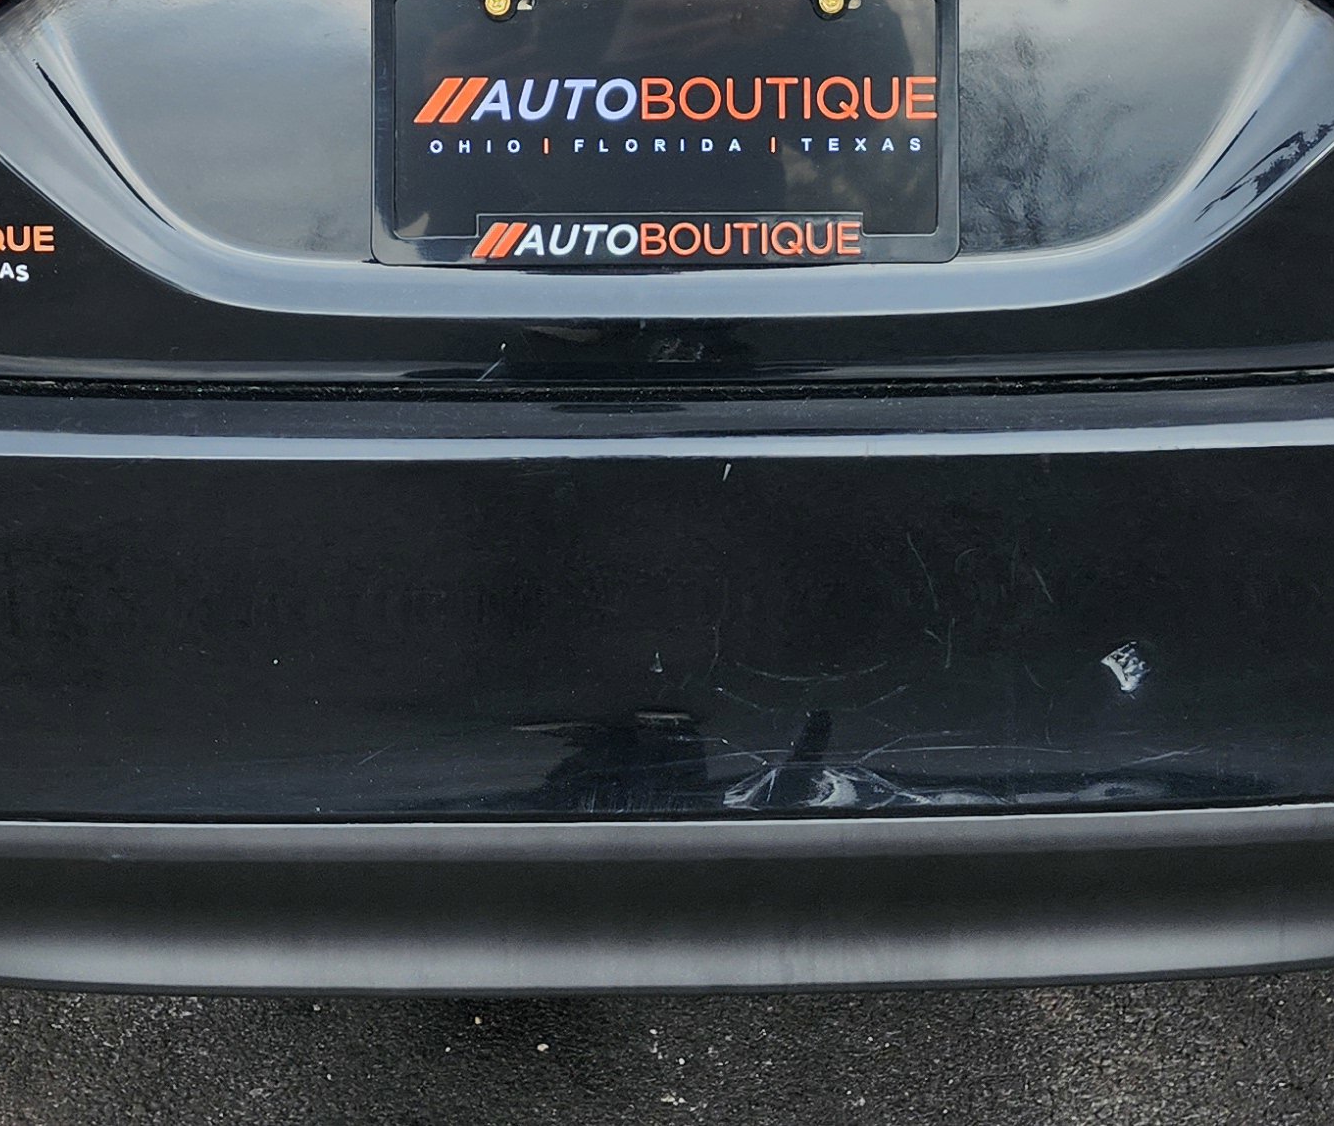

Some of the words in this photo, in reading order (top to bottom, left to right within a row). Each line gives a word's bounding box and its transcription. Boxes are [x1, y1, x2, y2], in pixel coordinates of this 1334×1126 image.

[471, 76, 938, 122] AUTOBOUTIQUE
[429, 139, 522, 155] OHIO
[573, 138, 743, 154] FLORIDA
[801, 137, 923, 153] TEXAS
[514, 221, 862, 258] AUTOBOUTIQUE
